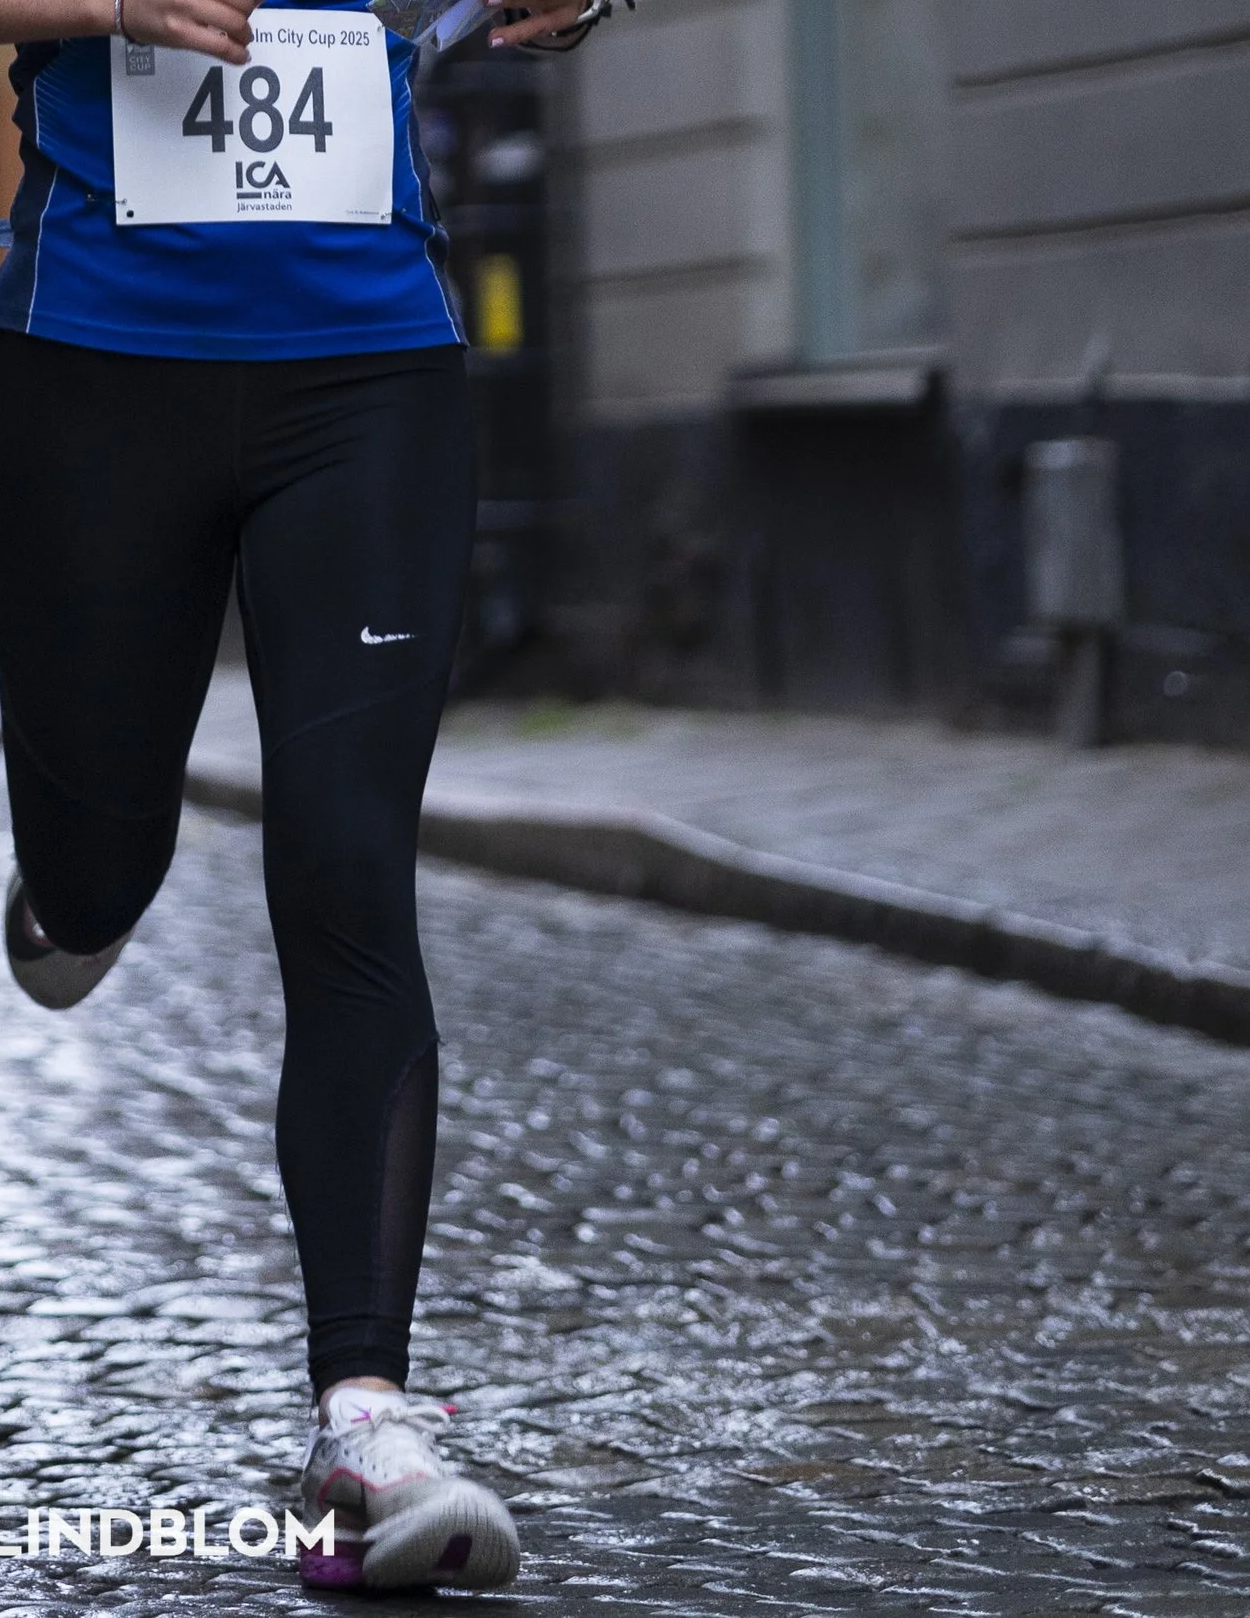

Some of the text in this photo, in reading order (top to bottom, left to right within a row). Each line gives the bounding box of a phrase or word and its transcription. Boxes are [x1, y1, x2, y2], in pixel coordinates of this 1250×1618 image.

[277, 28, 304, 48] City
[308, 30, 335, 48] Cup
[340, 31, 370, 46] 2025
[182, 65, 333, 153] 484
[235, 161, 290, 189] ICA
[263, 189, 292, 200] nära
